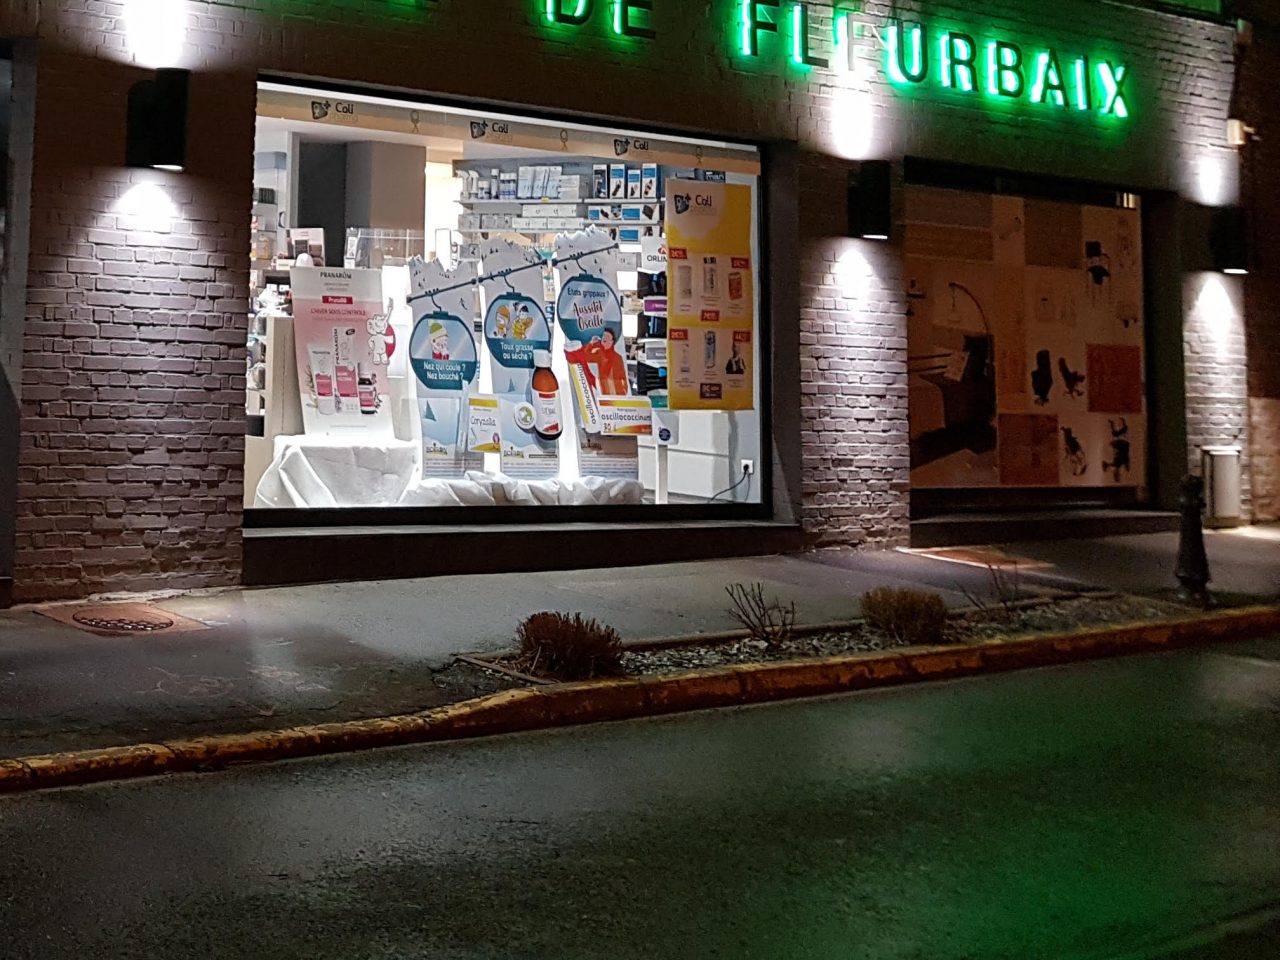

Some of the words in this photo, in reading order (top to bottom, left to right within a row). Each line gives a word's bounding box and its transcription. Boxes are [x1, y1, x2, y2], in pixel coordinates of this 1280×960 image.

[500, 342, 515, 350] Toux
[423, 361, 435, 370] Nez
[446, 362, 461, 371] coule
[426, 371, 438, 380] Nez
